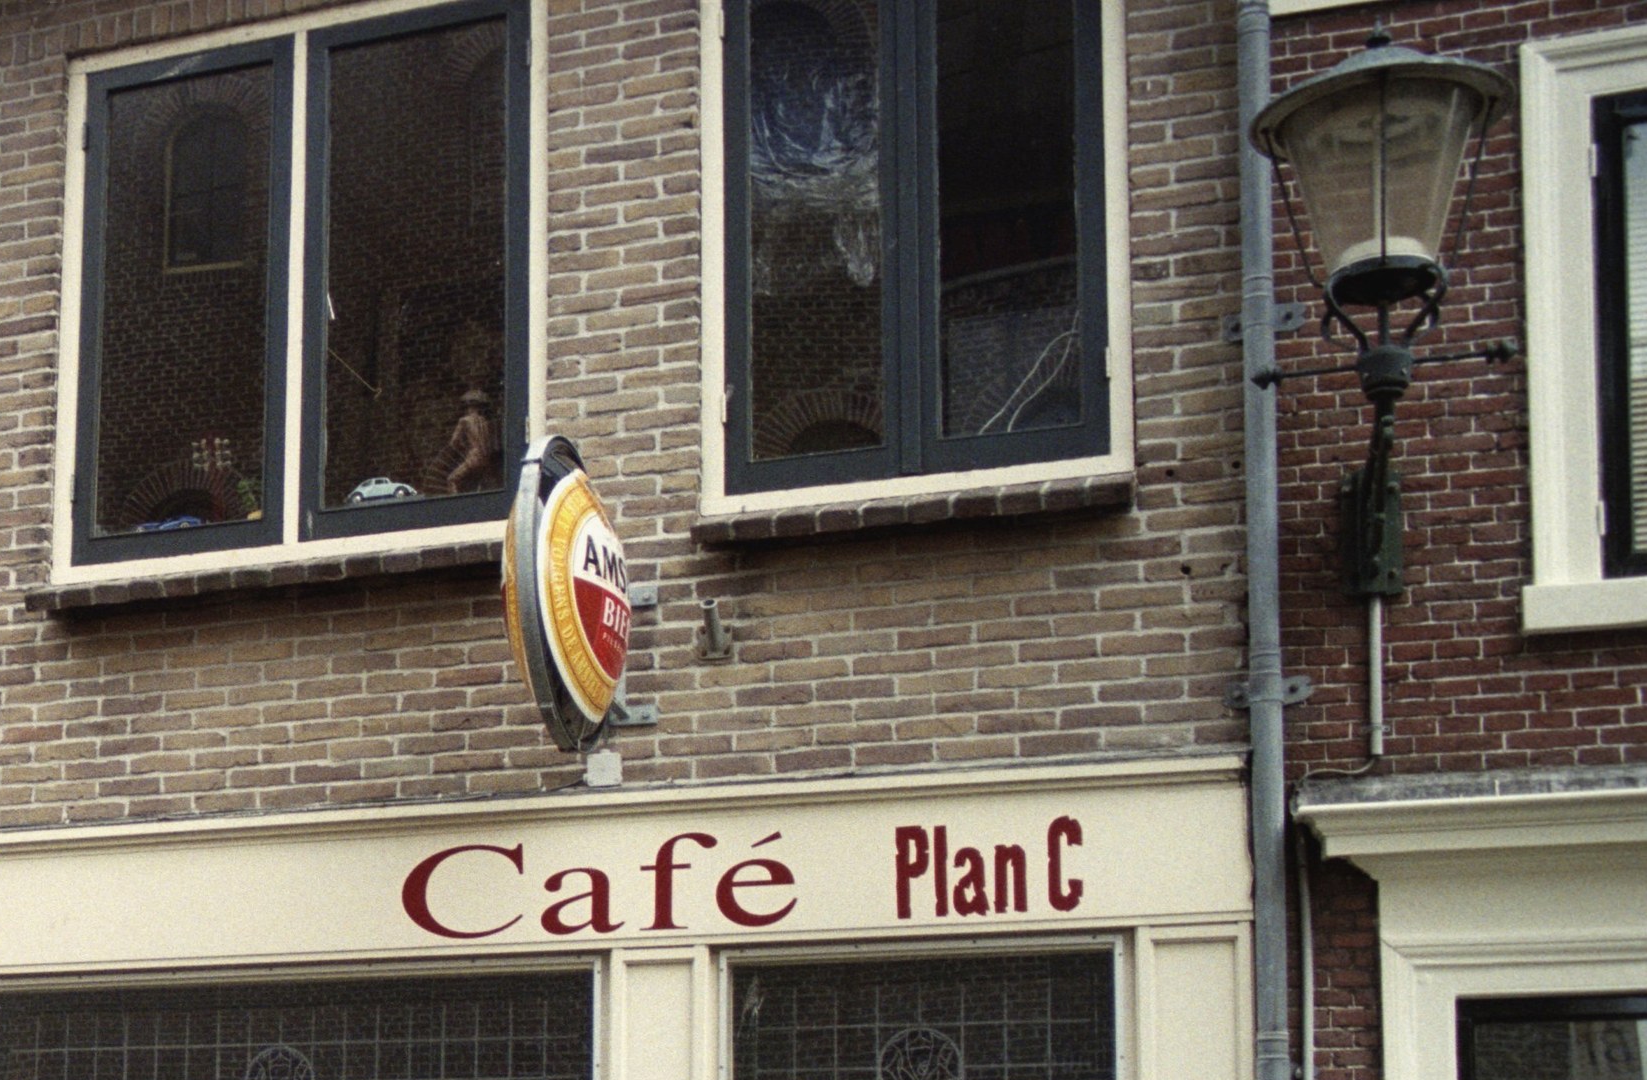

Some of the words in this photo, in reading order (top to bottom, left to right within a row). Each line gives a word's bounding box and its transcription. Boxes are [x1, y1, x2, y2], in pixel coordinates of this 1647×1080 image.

[401, 831, 799, 939] Café
[894, 824, 1028, 920] Plan
[1046, 814, 1085, 912] C
